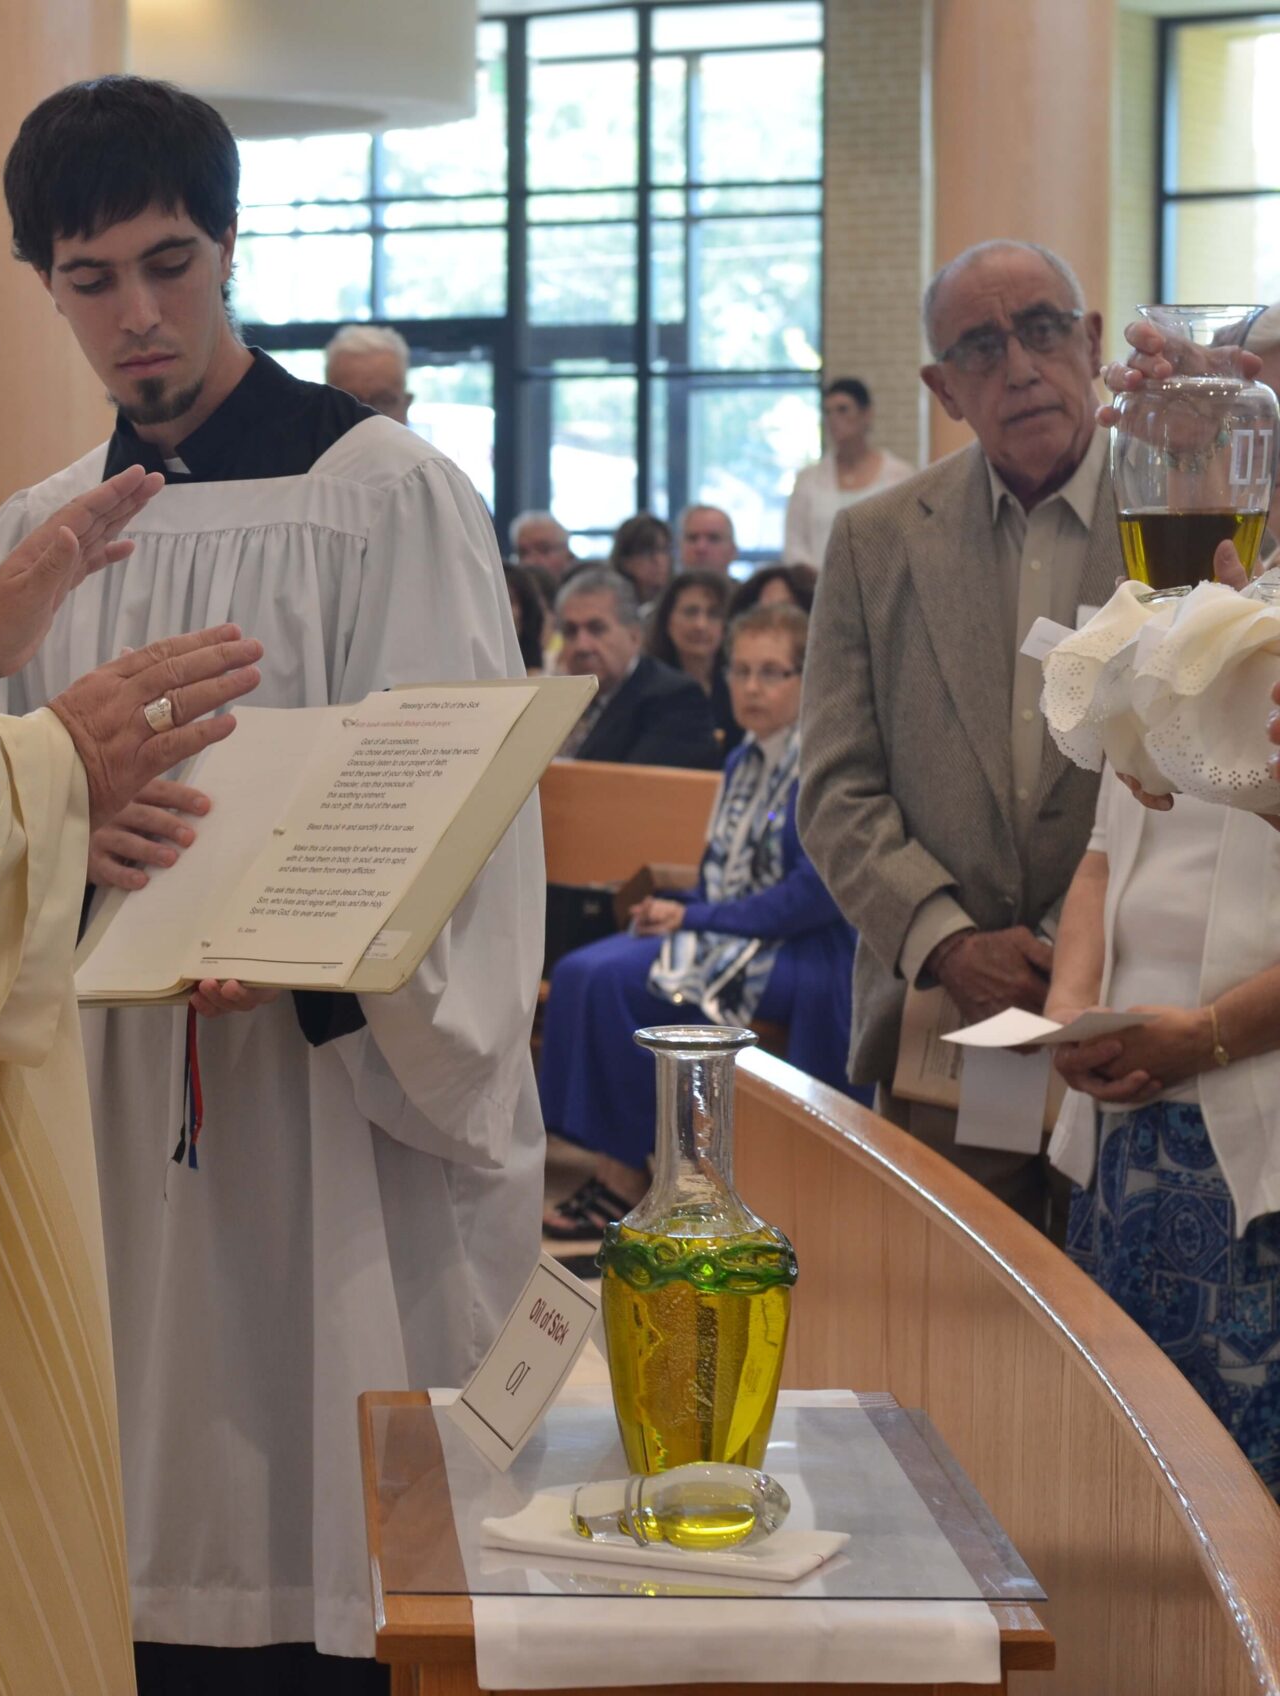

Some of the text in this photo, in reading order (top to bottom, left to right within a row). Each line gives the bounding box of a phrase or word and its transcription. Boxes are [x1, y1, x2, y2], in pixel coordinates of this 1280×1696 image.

[467, 702, 480, 710] Sick
[338, 792, 361, 800] soothing
[295, 888, 317, 896] through
[529, 1298, 570, 1346] Oil of Sick
